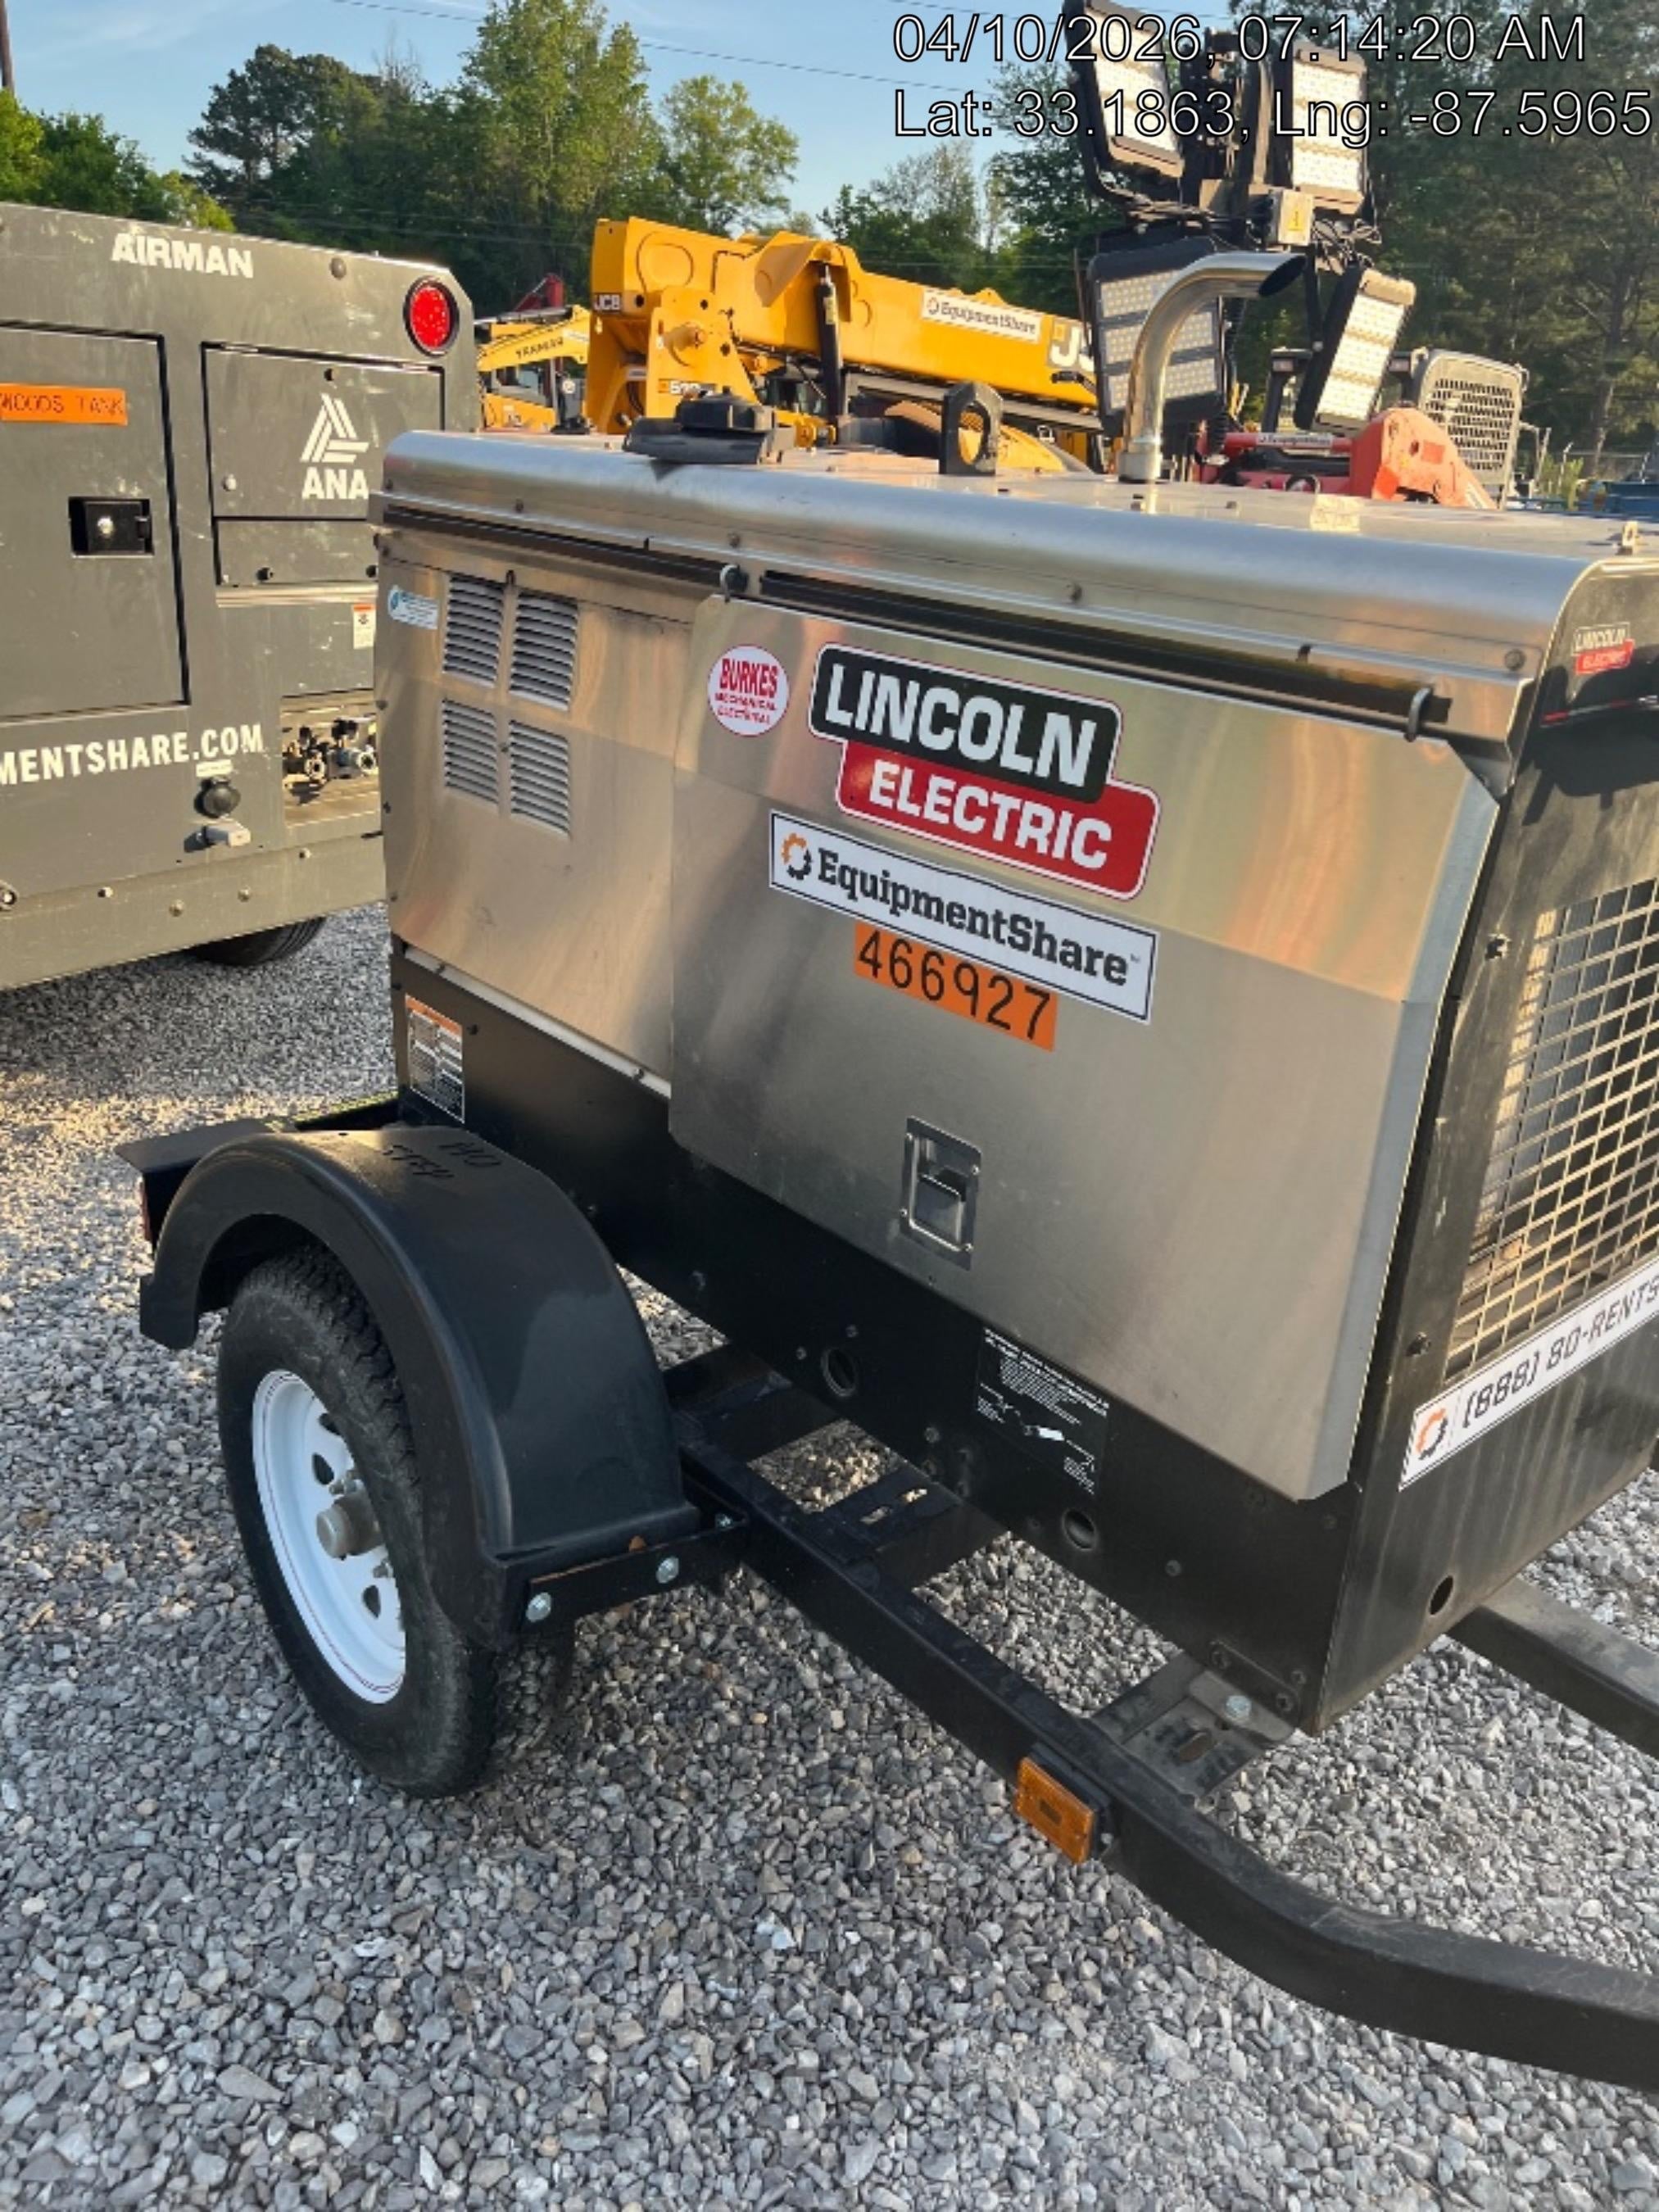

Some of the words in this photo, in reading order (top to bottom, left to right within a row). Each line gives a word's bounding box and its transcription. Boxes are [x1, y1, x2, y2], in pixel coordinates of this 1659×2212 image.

[111, 233, 254, 279] AIRMAN
[594, 294, 621, 311] JCB
[302, 466, 369, 499] ANA
[719, 657, 778, 699] BURKES
[824, 663, 1097, 787] LINCOLN
[868, 759, 1113, 869] ELECTRIC
[858, 928, 1051, 1040] 466927
